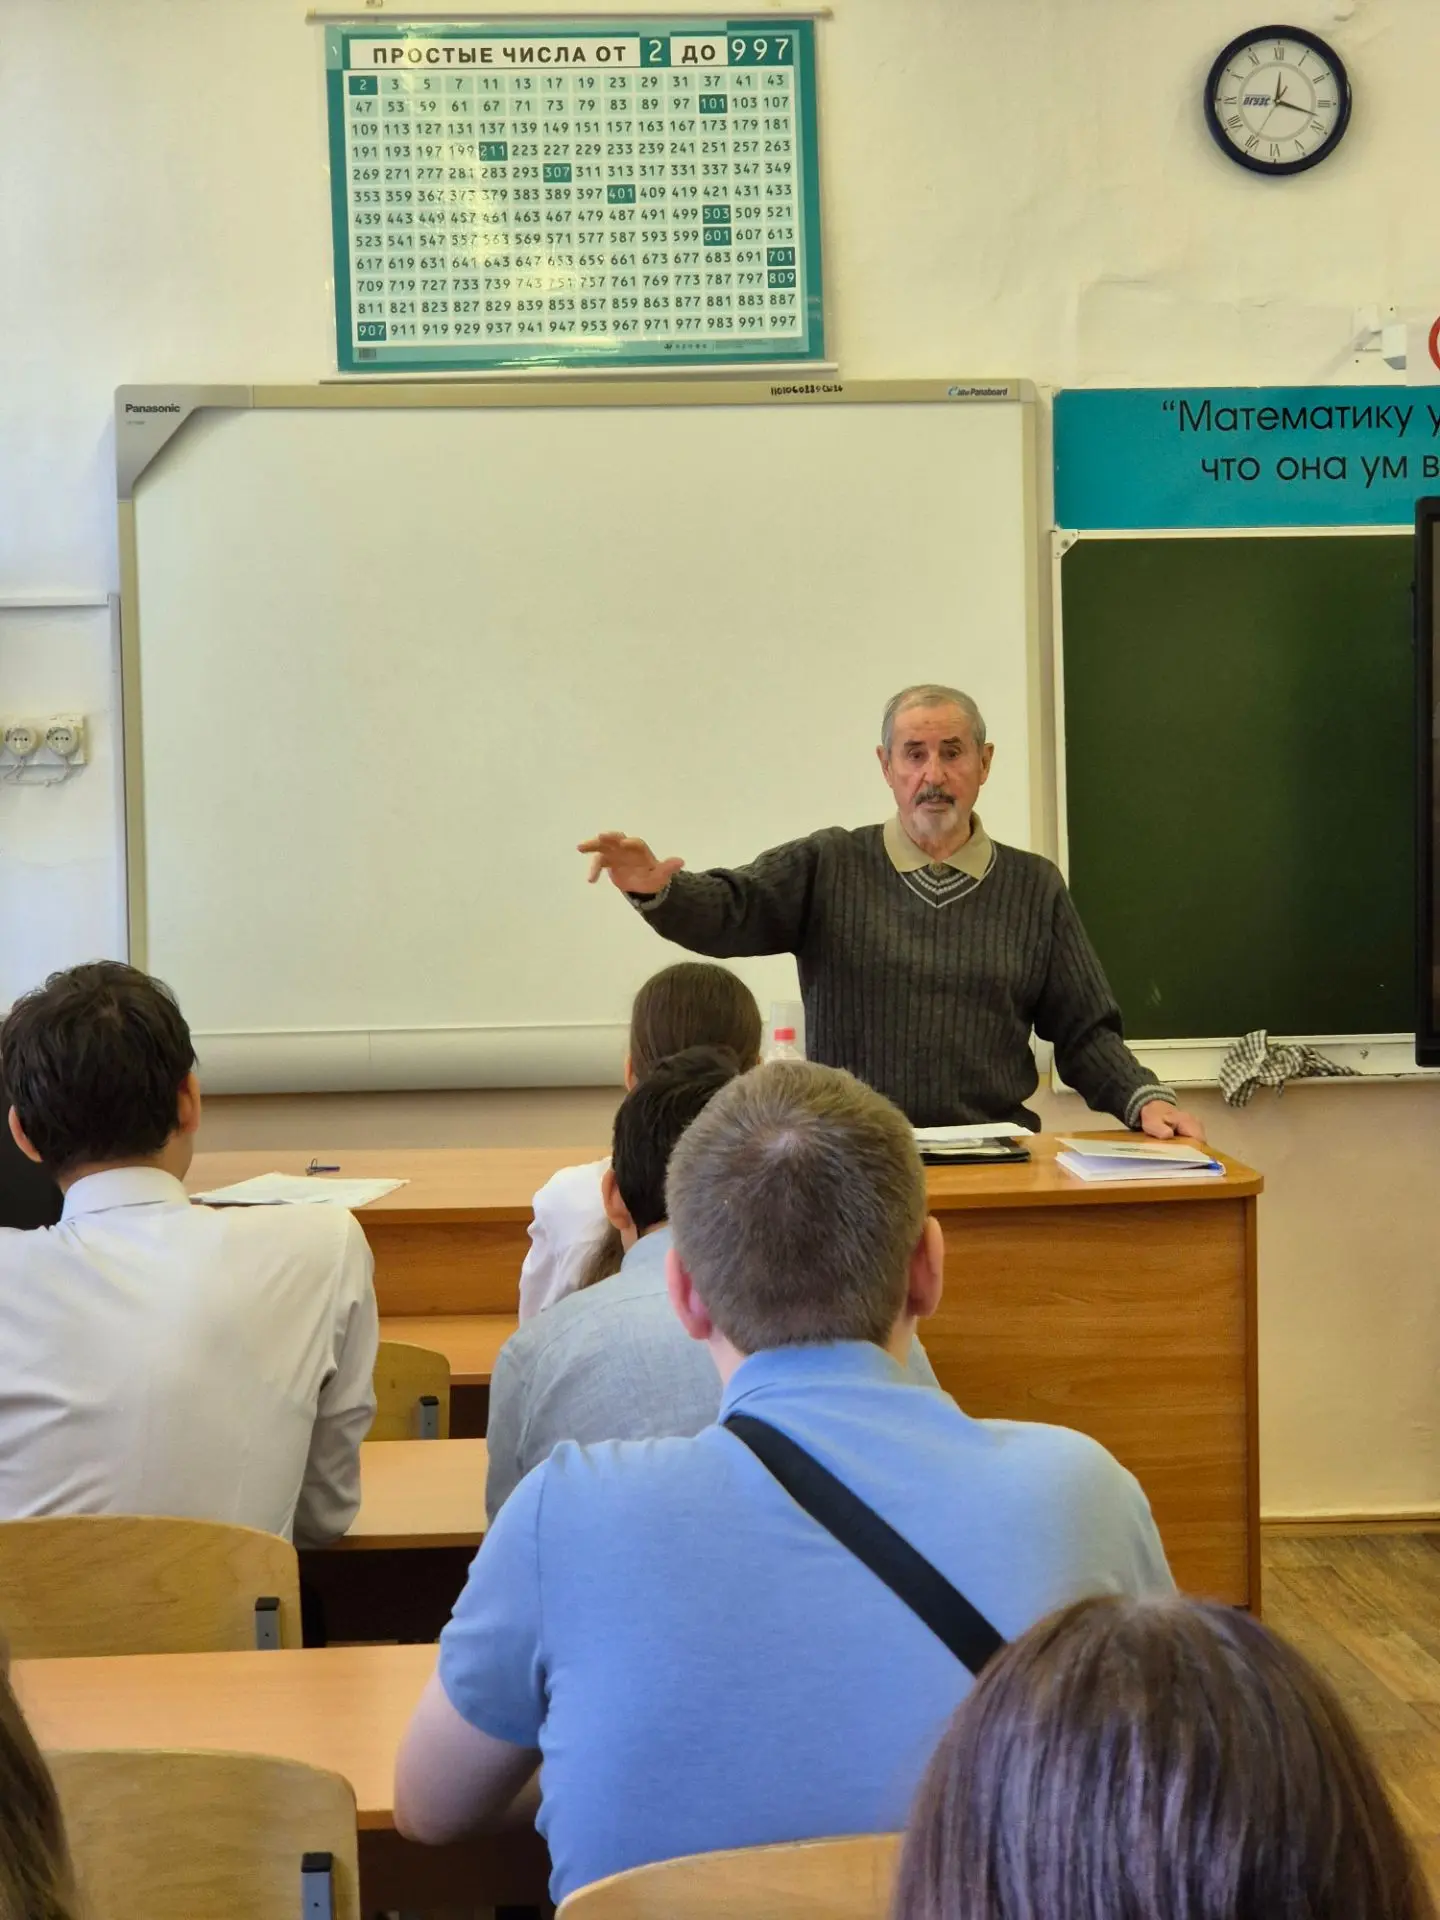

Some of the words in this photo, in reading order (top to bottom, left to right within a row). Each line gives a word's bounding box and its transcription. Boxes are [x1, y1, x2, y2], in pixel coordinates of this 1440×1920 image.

[372, 47, 493, 63] ПРОСТЫЕ
[503, 46, 586, 63] ЧИСЛА
[595, 46, 626, 62] ОТ
[649, 39, 663, 62] 2
[681, 45, 716, 64] ДО
[731, 38, 789, 60] 997
[483, 78, 497, 89] 11
[515, 78, 531, 89] 13
[547, 77, 562, 88] 17
[579, 77, 594, 88] 19
[610, 77, 626, 88] 23
[642, 76, 657, 88] 29
[673, 76, 687, 87] 31
[704, 76, 720, 87] 37
[736, 75, 750, 86] 41
[768, 75, 784, 85] 43
[356, 102, 372, 113] 47
[388, 101, 404, 112] 53
[420, 101, 436, 112] 59
[452, 101, 466, 112] 61
[483, 100, 499, 112] 67
[515, 100, 530, 112] 71
[547, 100, 563, 111] 73
[579, 100, 595, 111] 79
[610, 99, 627, 110] 83
[642, 99, 658, 110] 89
[674, 98, 690, 109] 97
[700, 97, 724, 109] 101
[732, 97, 757, 108] 103
[764, 96, 789, 108] 107
[352, 124, 378, 136] 109
[384, 124, 410, 135] 113
[448, 123, 472, 134] 131
[480, 123, 505, 134] 137
[512, 122, 537, 134] 139
[544, 122, 569, 133] 149
[576, 122, 599, 133] 151
[639, 121, 663, 132] 163
[670, 120, 695, 131] 167
[733, 119, 758, 130] 179
[764, 119, 788, 130] 181
[353, 146, 377, 158] 191
[385, 146, 410, 157] 193
[481, 144, 505, 156] 211
[512, 144, 538, 156] 223
[544, 144, 569, 156] 227
[576, 144, 601, 155] 229
[608, 144, 633, 155] 233
[702, 142, 725, 153] 251
[733, 141, 759, 152] 257
[765, 140, 790, 152] 263
[353, 169, 379, 180] 269
[385, 168, 409, 180] 271
[513, 167, 538, 178] 293
[545, 166, 571, 177] 307
[576, 166, 600, 177] 311
[640, 165, 665, 176] 317
[671, 165, 695, 175] 331
[734, 163, 759, 175] 347
[765, 162, 791, 174] 349
[354, 191, 381, 202] 353
[386, 191, 412, 202] 359
[514, 189, 539, 200] 383
[546, 189, 571, 200] 389
[577, 188, 602, 200] 397
[609, 187, 633, 199] 401
[703, 186, 727, 197] 421
[735, 185, 758, 196] 431
[766, 184, 791, 195] 433
[355, 213, 381, 225] 439
[387, 213, 414, 224] 443
[515, 211, 540, 222] 463
[546, 211, 571, 222] 467
[578, 210, 603, 221] 479
[641, 209, 664, 220] 491
[673, 208, 698, 220] 499
[704, 207, 729, 219] 503
[736, 207, 761, 218] 509
[767, 206, 790, 217] 521
[356, 236, 382, 247] 523
[388, 235, 412, 246] 541
[420, 234, 446, 246] 547
[515, 233, 541, 244] 569
[547, 233, 570, 244] 571
[579, 232, 604, 243] 577
[610, 232, 635, 243] 587
[705, 229, 729, 241] 601
[736, 229, 761, 240] 607
[768, 228, 793, 239] 613
[357, 258, 382, 270] 617
[389, 258, 414, 269] 619
[484, 256, 510, 268] 643
[642, 253, 668, 264] 673
[674, 252, 699, 264] 677
[737, 251, 760, 263] 691
[768, 250, 792, 262] 701
[357, 281, 383, 292] 709
[389, 280, 415, 291] 719
[422, 279, 447, 291] 727
[485, 279, 511, 289] 739
[612, 276, 635, 287] 761
[706, 274, 731, 285] 787
[738, 273, 763, 284] 797
[769, 272, 795, 284] 809
[358, 303, 382, 314] 811
[390, 302, 414, 313] 821
[454, 301, 479, 312] 827
[486, 300, 511, 312] 829
[518, 300, 543, 311] 839
[549, 299, 574, 310] 853
[581, 298, 606, 310] 857
[644, 297, 669, 308] 863
[676, 296, 701, 307] 877
[738, 295, 763, 306] 883
[770, 294, 795, 305] 887
[359, 325, 385, 337] 907
[391, 324, 415, 335] 911
[423, 324, 448, 334] 919
[487, 322, 512, 333] 937
[519, 322, 542, 332] 941
[550, 321, 575, 332] 947
[582, 320, 607, 331] 953
[613, 320, 638, 330] 967
[707, 317, 733, 328] 983
[739, 317, 763, 328] 991
[770, 315, 796, 327] 997
[125, 403, 181, 413] Panasonic
[1162, 399, 1414, 438] “Математику
[1201, 456, 1261, 481] что
[1276, 455, 1347, 480] она
[1360, 455, 1408, 488] ум
